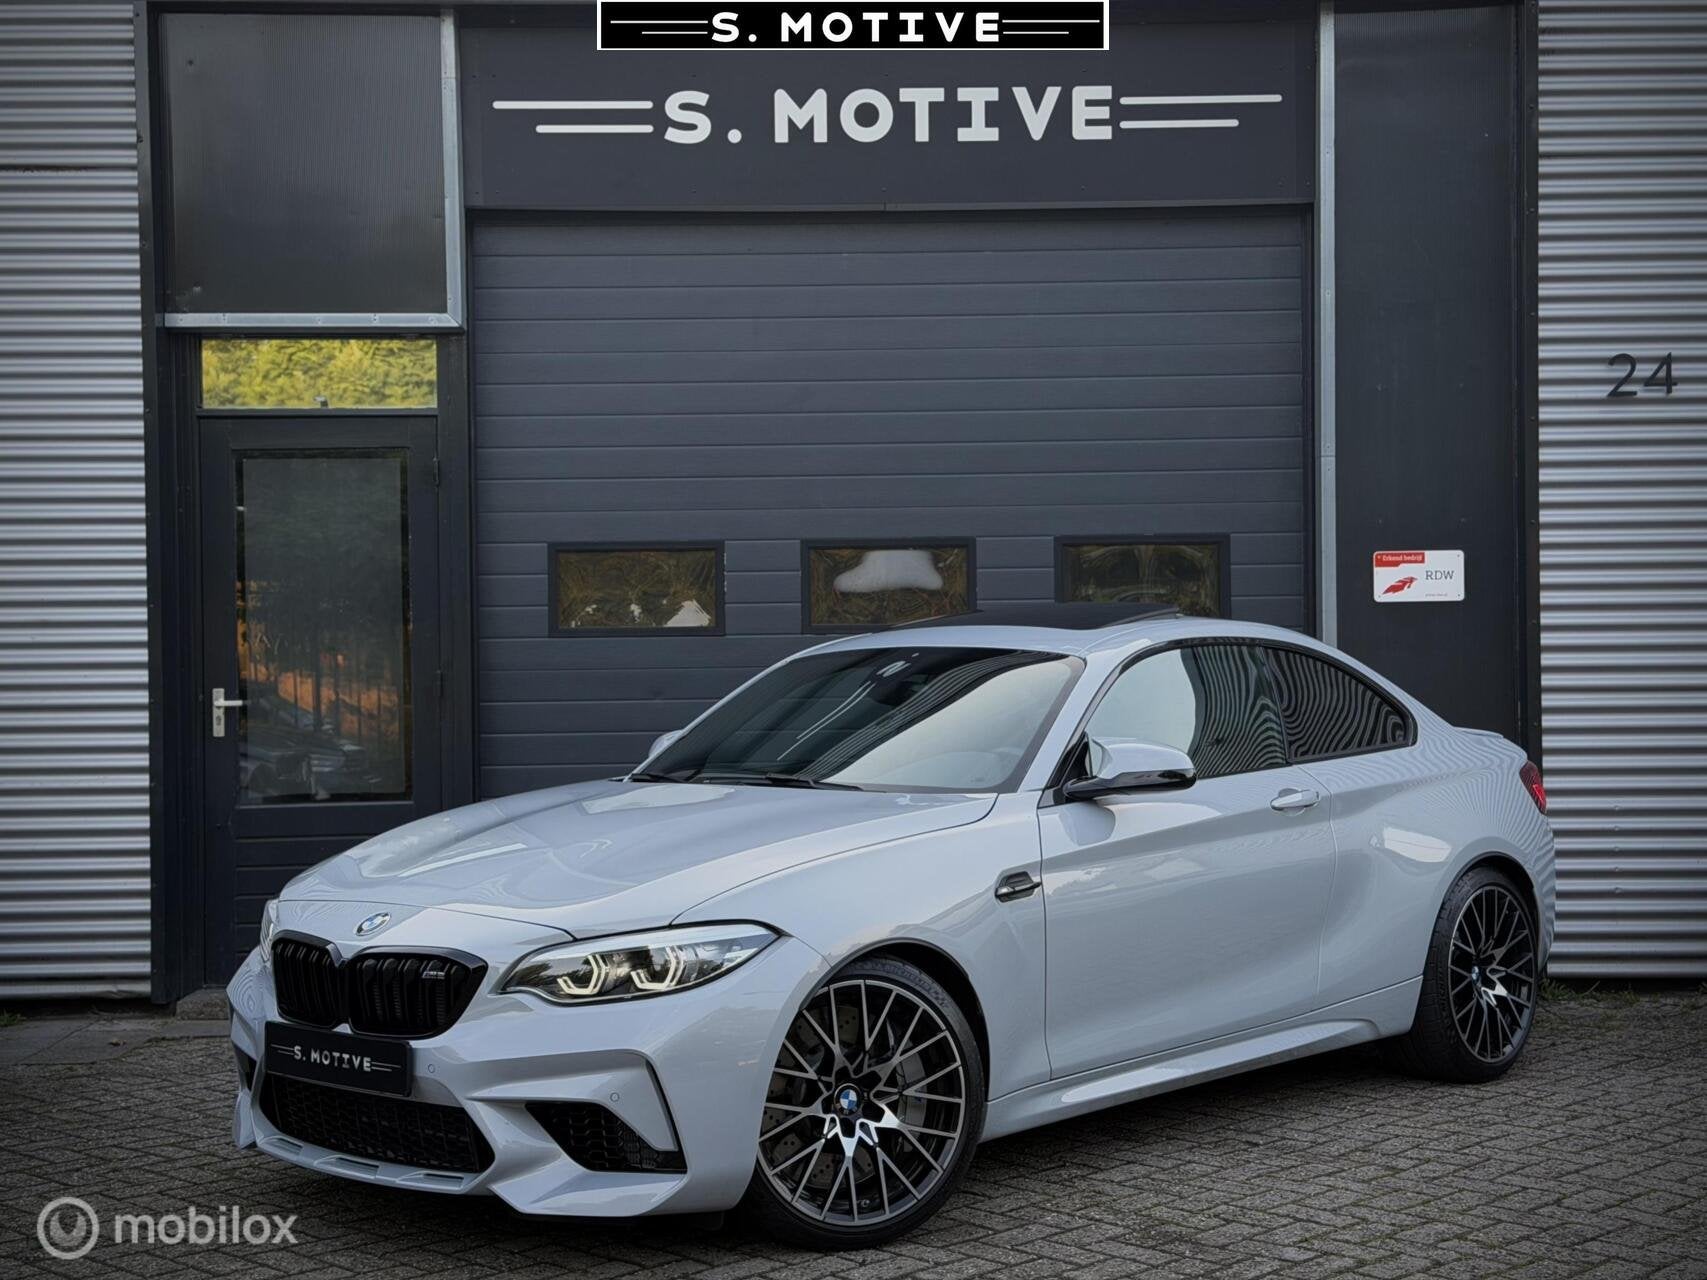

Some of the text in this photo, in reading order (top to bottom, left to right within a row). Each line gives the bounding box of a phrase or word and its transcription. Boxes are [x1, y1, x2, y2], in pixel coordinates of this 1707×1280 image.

[663, 85, 1113, 145] S. MOTIVE
[1606, 351, 1679, 398] 24
[1425, 569, 1455, 581] RDW
[293, 1045, 372, 1073] S. MOTIVE
